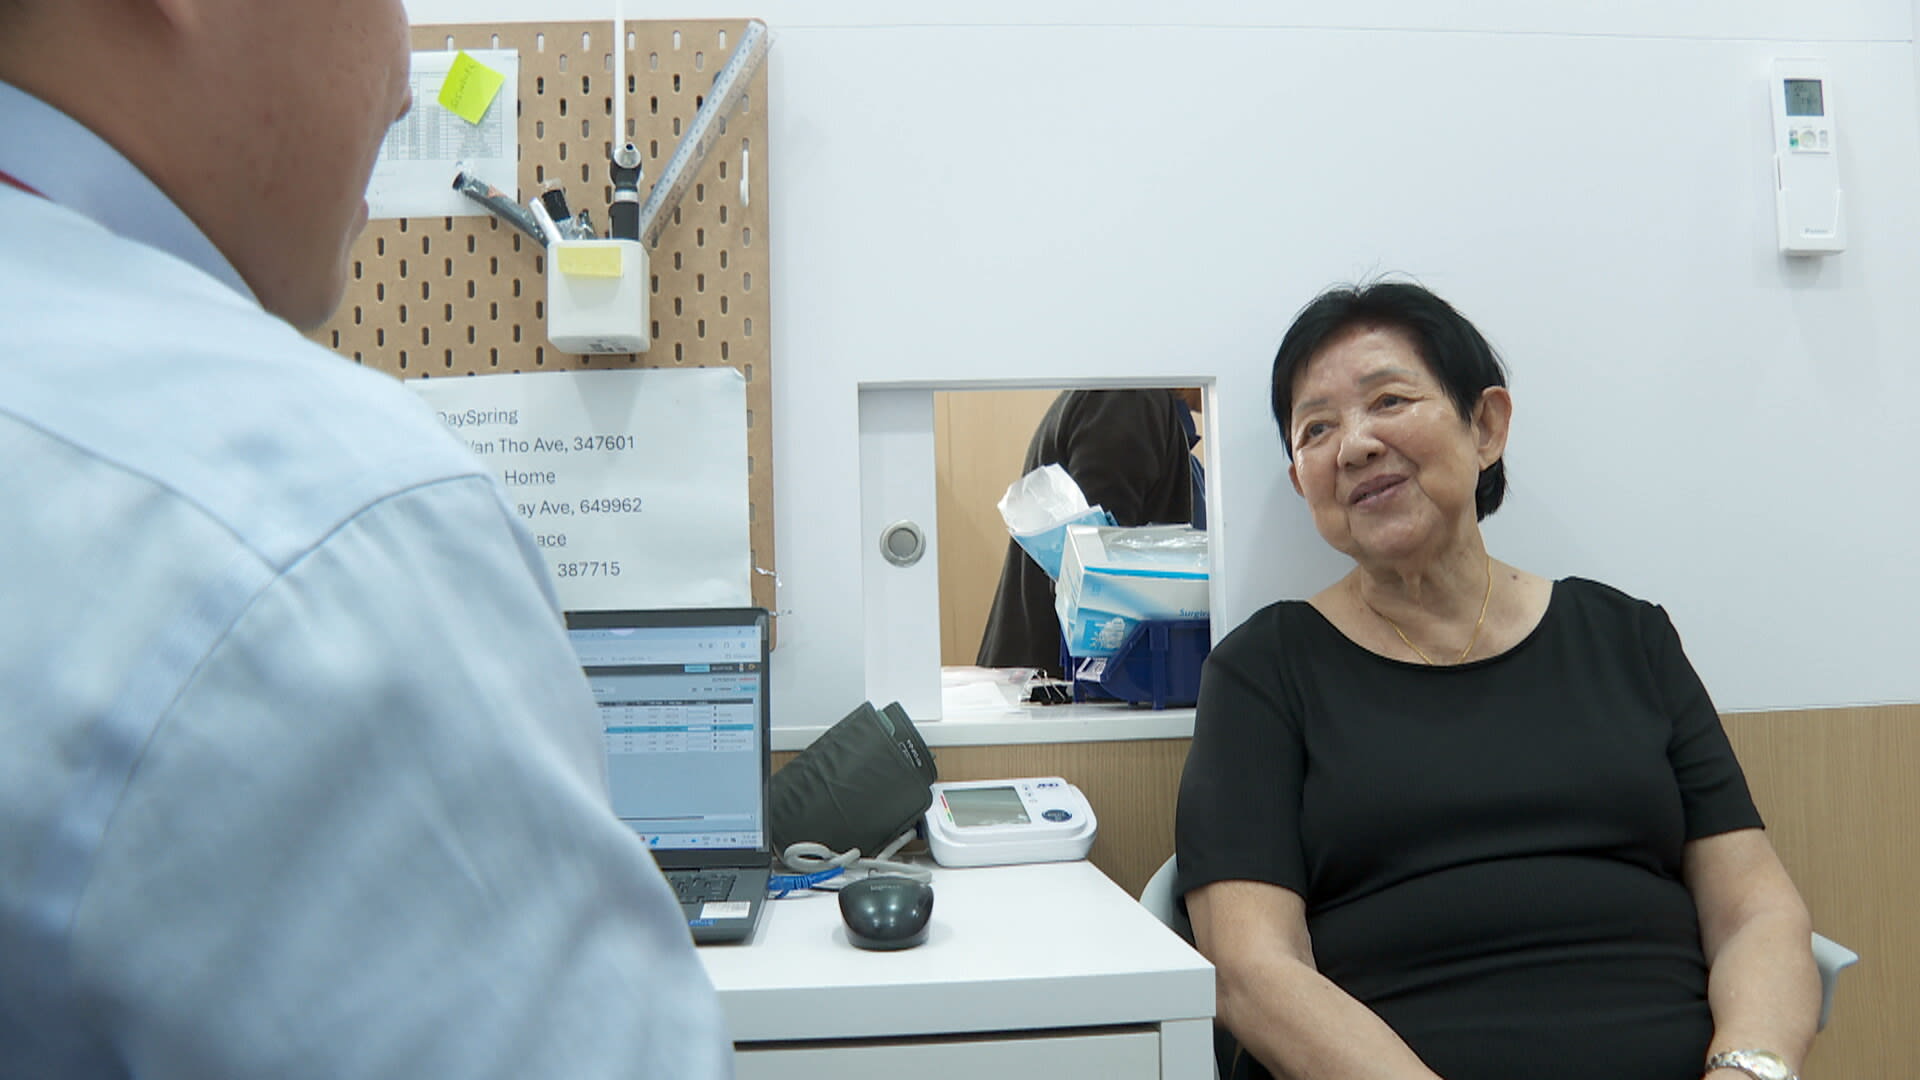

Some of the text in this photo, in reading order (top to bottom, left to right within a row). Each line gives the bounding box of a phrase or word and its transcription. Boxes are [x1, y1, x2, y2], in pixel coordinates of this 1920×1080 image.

[499, 437, 529, 453] Tho
[534, 436, 568, 454] Ave,
[573, 435, 634, 451] 347601
[504, 469, 556, 485] Home
[540, 500, 575, 516] Ave,
[580, 498, 642, 514] 649962
[535, 533, 567, 547] ace
[558, 561, 621, 577] 387715
